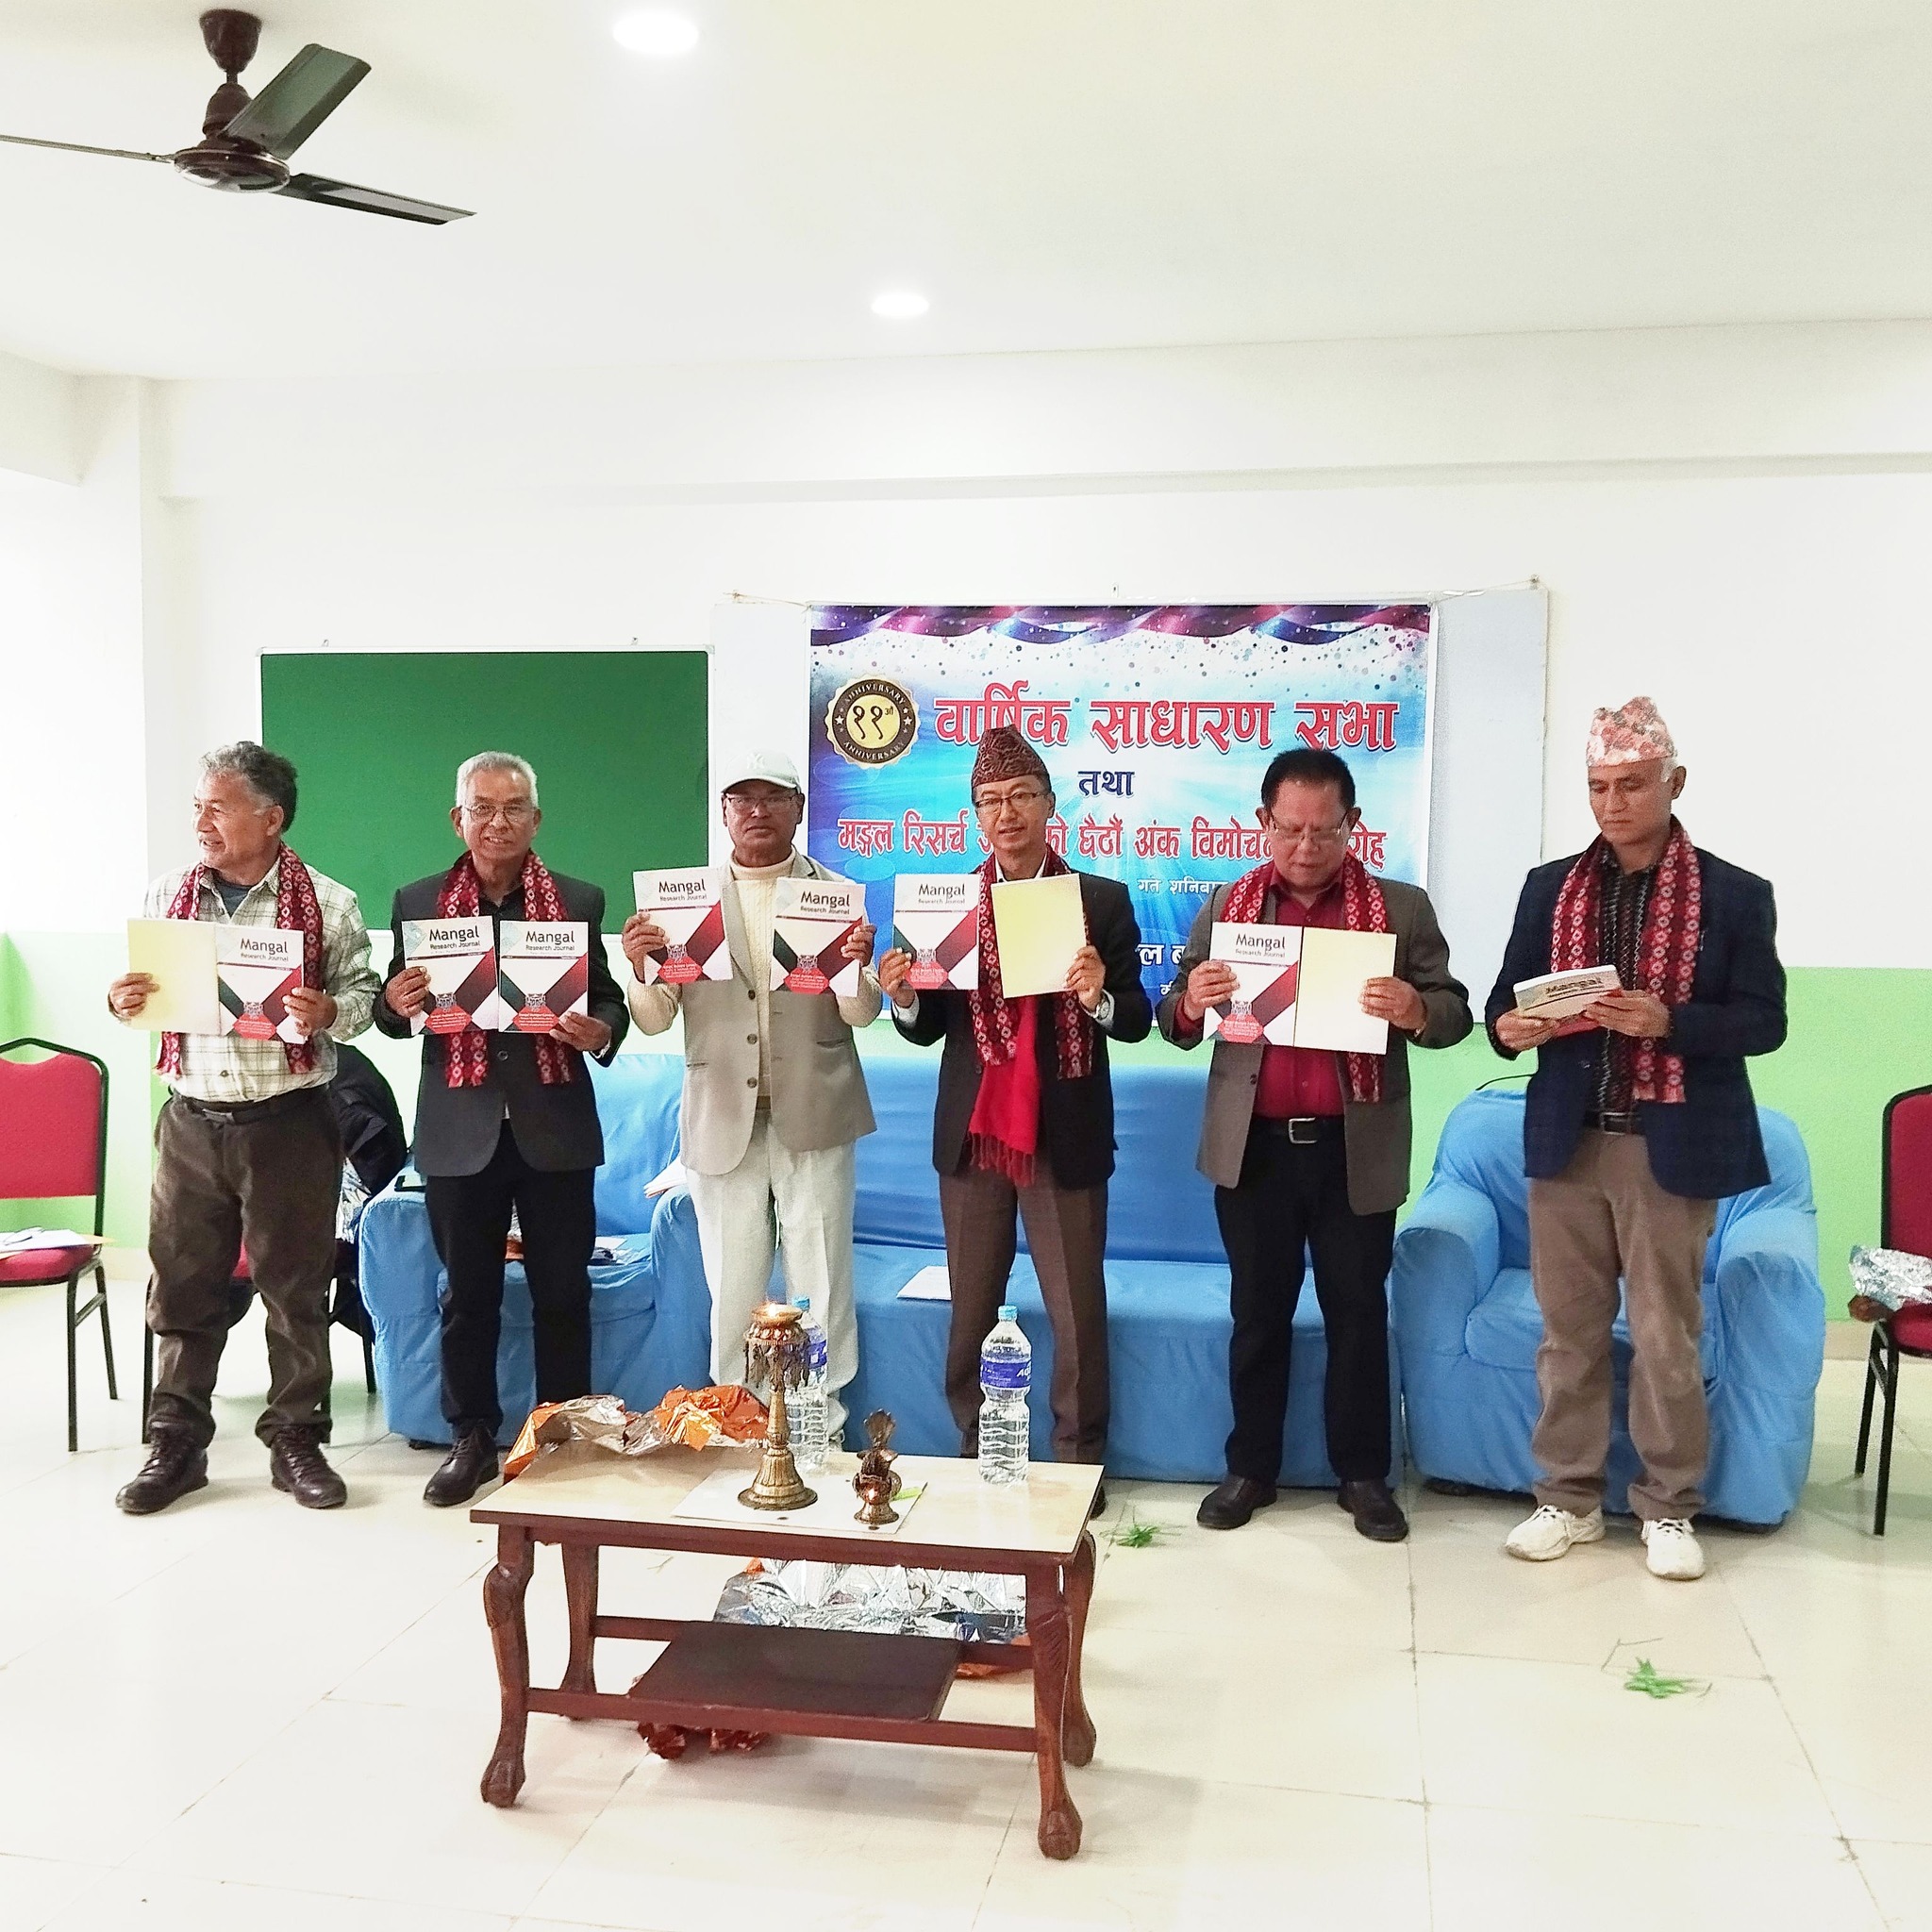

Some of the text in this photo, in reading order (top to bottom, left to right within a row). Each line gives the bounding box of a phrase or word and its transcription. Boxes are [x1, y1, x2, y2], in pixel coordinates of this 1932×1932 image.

[934, 679, 1399, 752] वार्षिक साधारण सभा
[843, 741, 906, 760] ANNIVERSARY
[1078, 770, 1135, 797] तथा
[839, 820, 894, 857] मङ्गल
[903, 809, 969, 856] रिसर्च
[1134, 819, 1181, 858] अंक
[658, 878, 707, 894] Mangal
[918, 883, 965, 899] Mangal
[800, 891, 850, 908] Mangal
[828, 907, 850, 915] Journal
[429, 925, 479, 942] Mangal
[525, 930, 575, 945] Mangal
[240, 938, 289, 956] Mangal
[458, 941, 480, 949] Journal
[1235, 934, 1286, 952] Mangal
[240, 952, 290, 962] Research Journal
